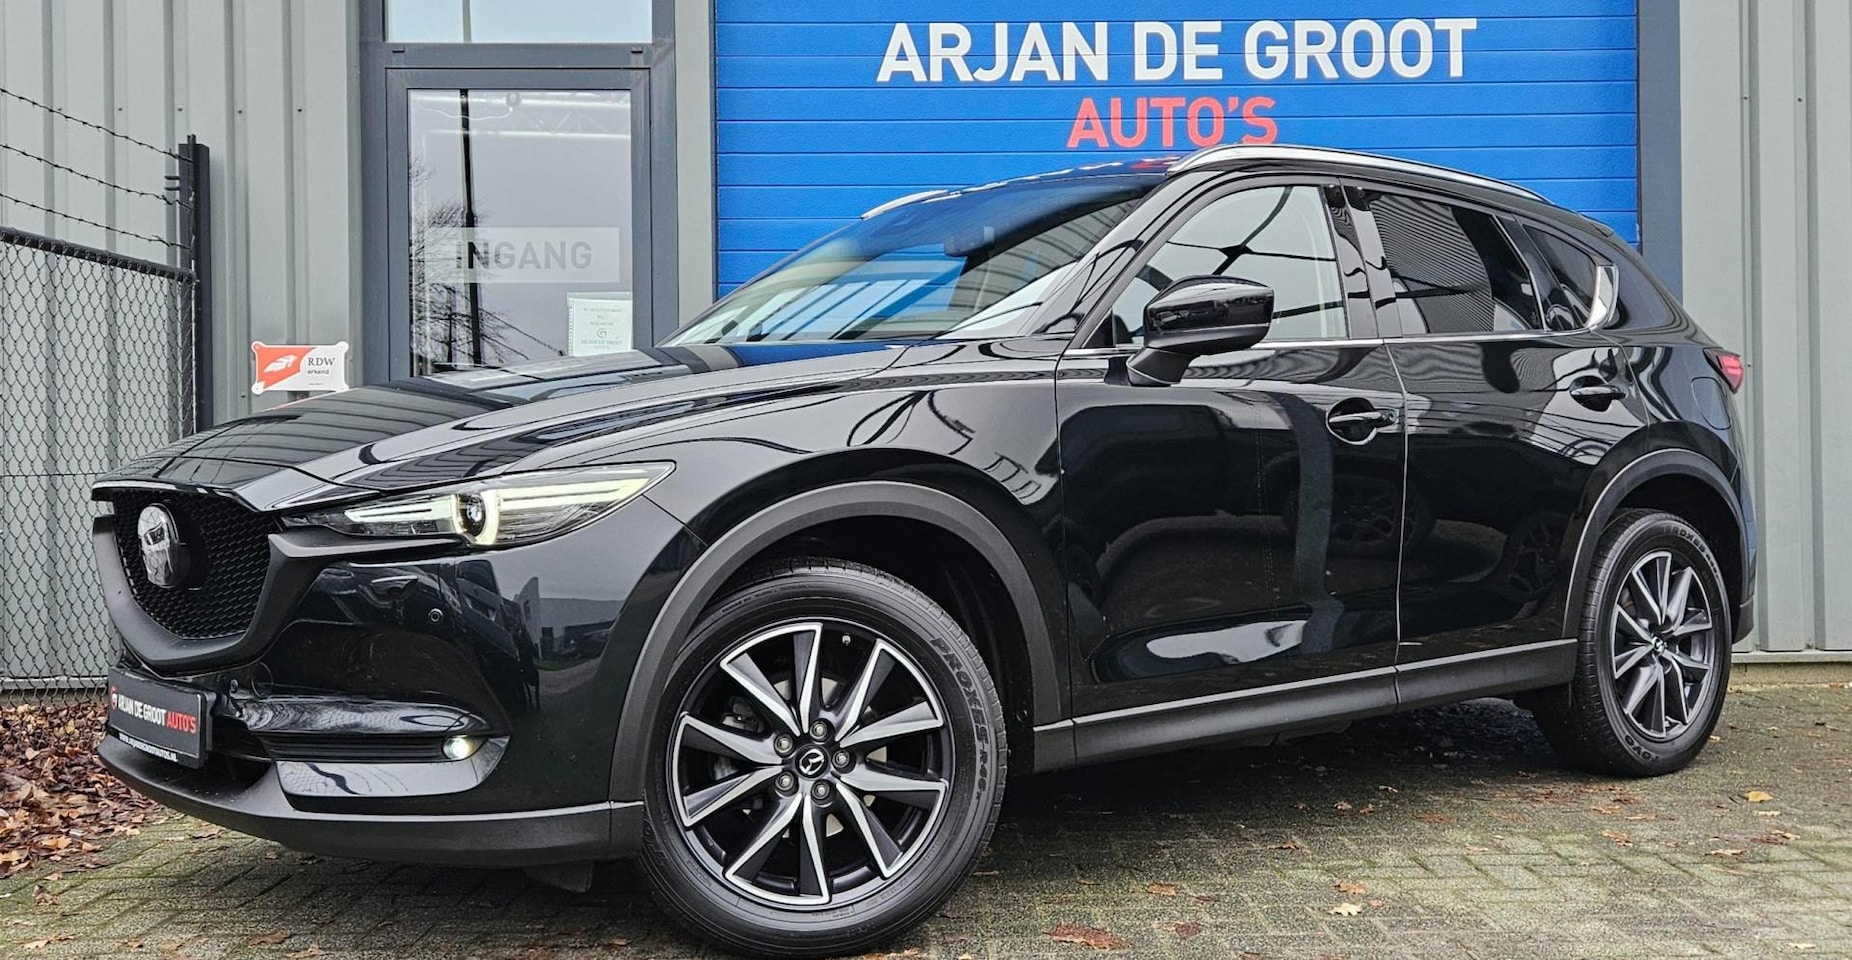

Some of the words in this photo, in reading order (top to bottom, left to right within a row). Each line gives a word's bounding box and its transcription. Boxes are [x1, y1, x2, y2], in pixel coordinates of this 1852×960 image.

[875, 22, 1108, 83] ARJAN
[1133, 20, 1223, 81] DE
[1243, 18, 1477, 80] GROOT
[1066, 96, 1278, 149] AUTO'S
[456, 240, 592, 270] INGANG
[307, 357, 336, 367] RDW
[118, 693, 134, 716] ARJAN
[134, 700, 144, 719] DE
[143, 703, 167, 727] GROOT
[167, 710, 198, 736] AUTO'S
[929, 636, 990, 745] PROXES
